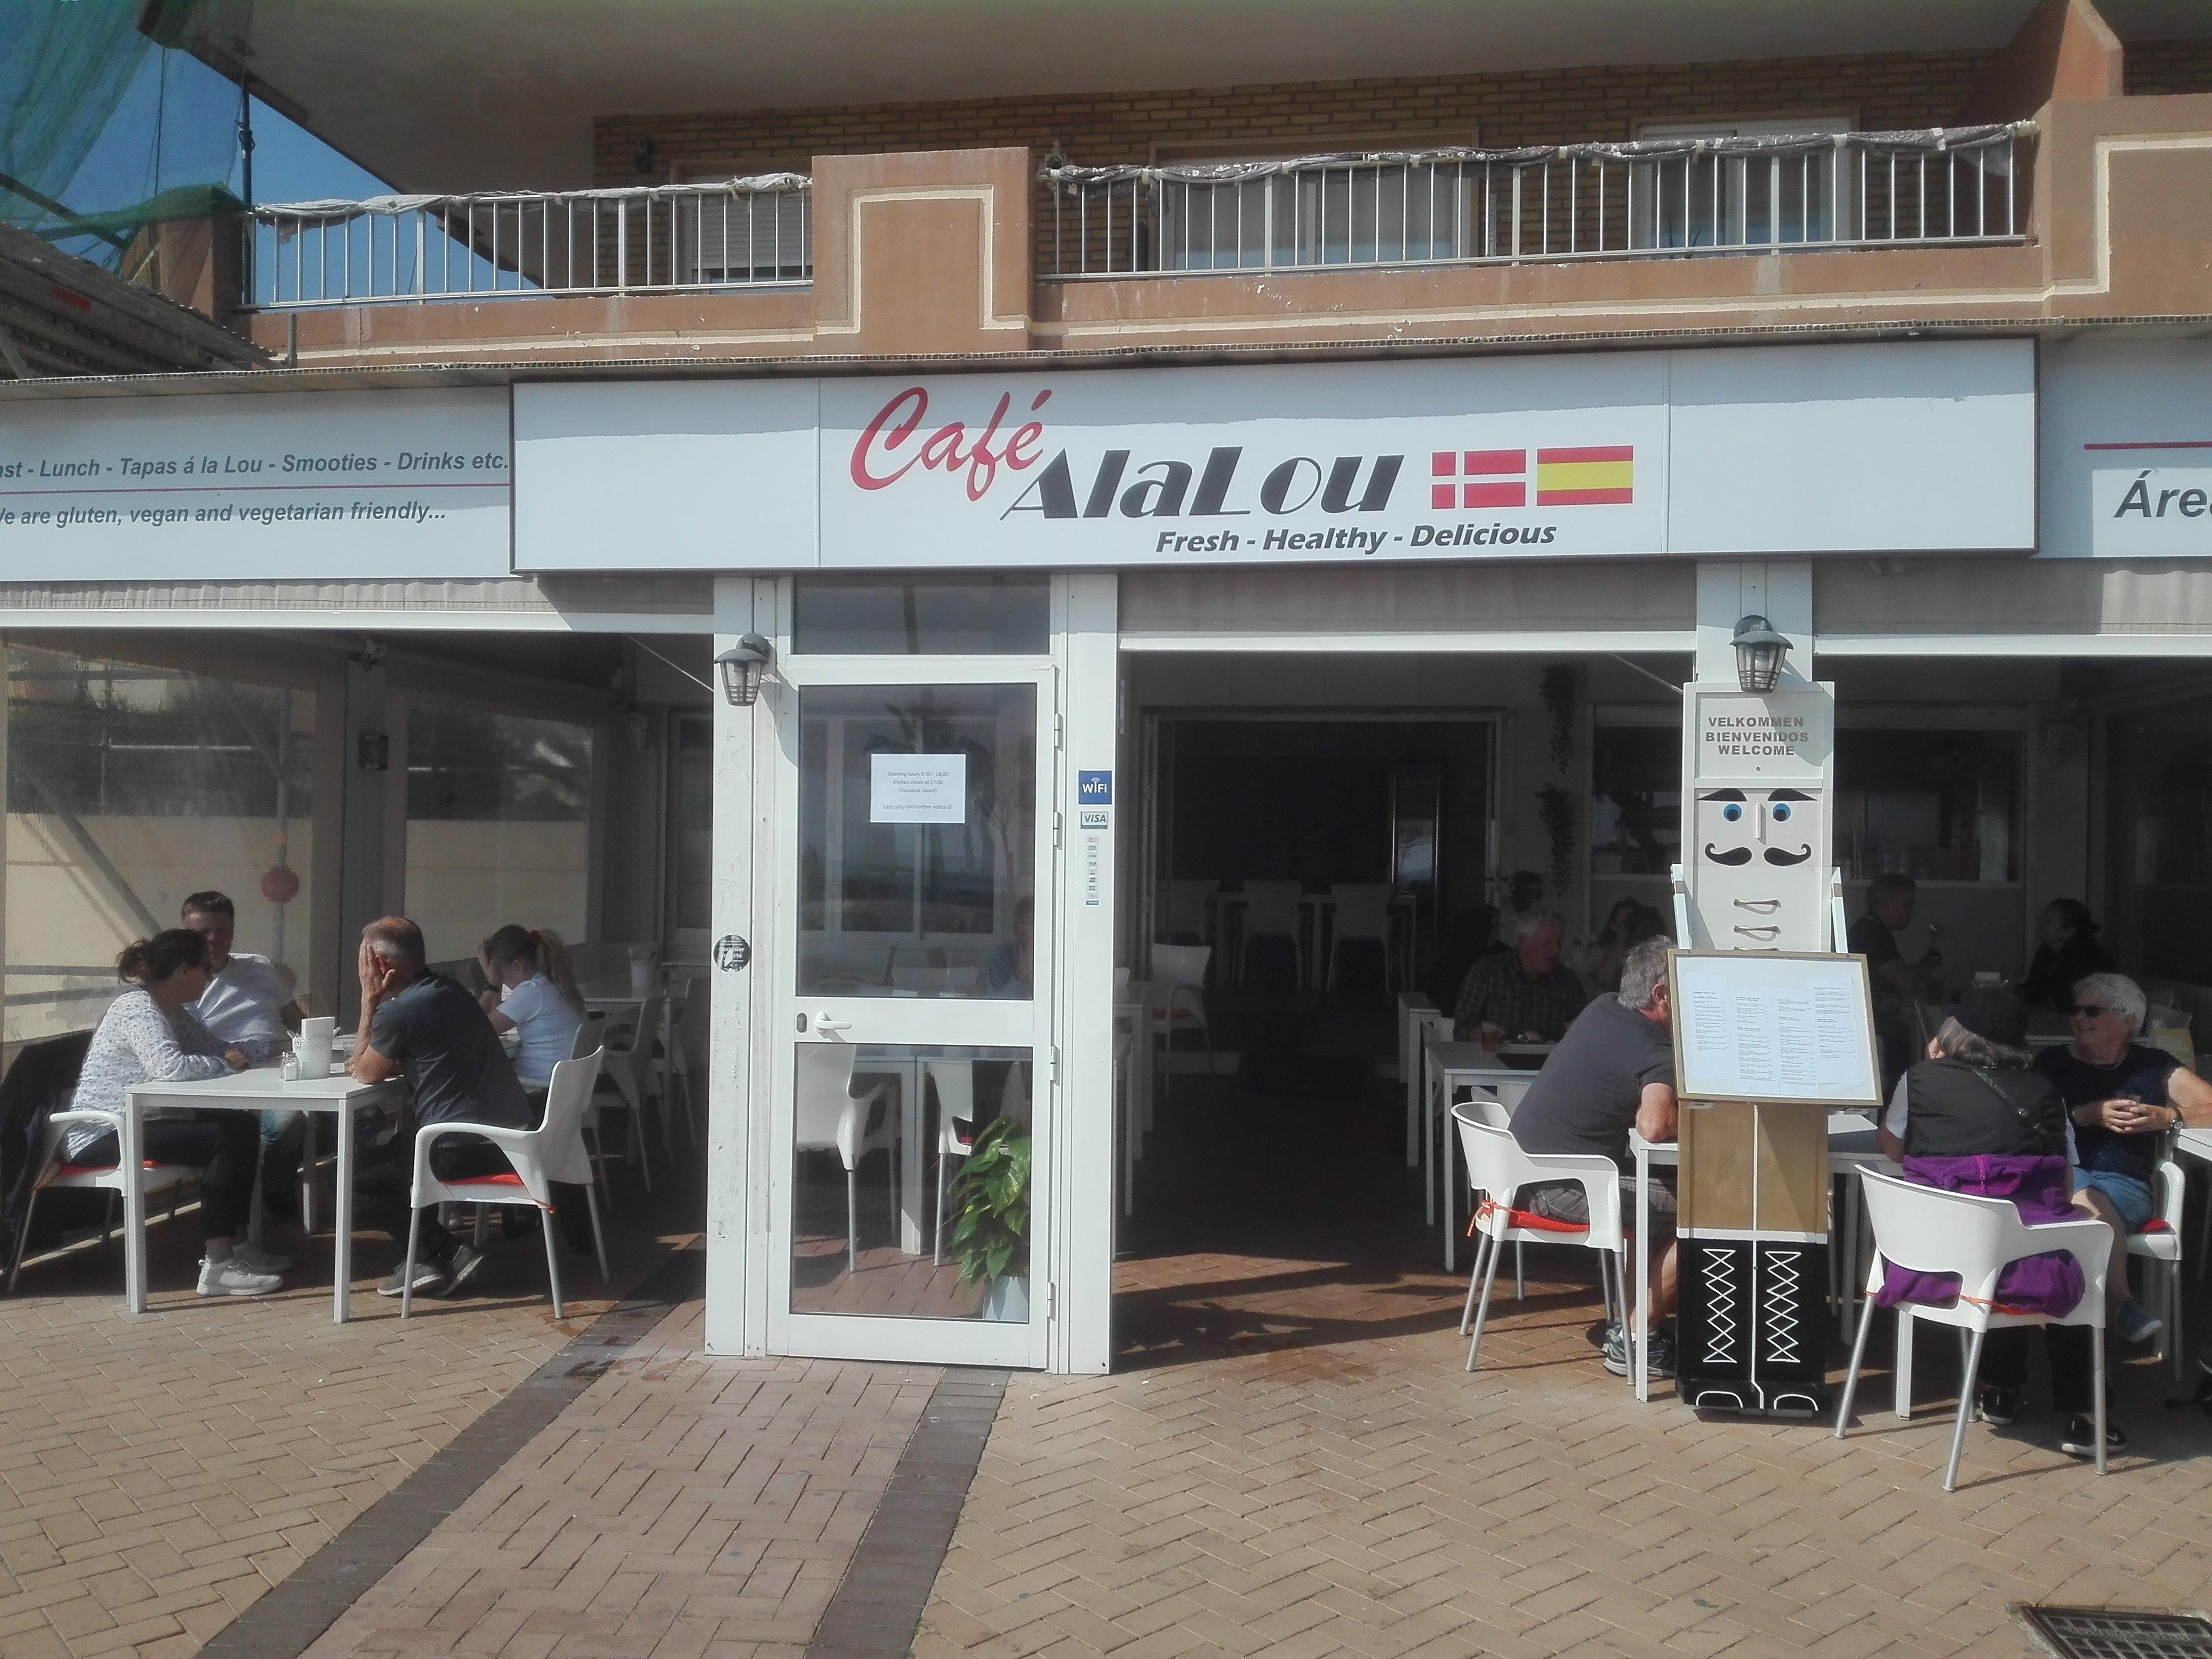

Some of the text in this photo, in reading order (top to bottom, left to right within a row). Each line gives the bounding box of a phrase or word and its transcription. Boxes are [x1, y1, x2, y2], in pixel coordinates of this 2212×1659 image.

[850, 387, 1052, 501] Café
[0, 461, 23, 477] st
[39, 458, 100, 477] Lunch
[120, 457, 178, 479] Tapas
[183, 456, 195, 474] á
[200, 456, 218, 474] la
[224, 456, 263, 473] Lou
[281, 453, 378, 473] Smooties
[397, 451, 465, 471] Drinks
[472, 451, 508, 470] etc.
[999, 446, 1405, 521] AlaLou
[2113, 470, 2212, 518] Áre
[0, 501, 446, 529] e are gluten, vegan and vegetarian friendly...
[1155, 530, 1239, 552] Fresh
[1262, 526, 1389, 555] Healthy
[1410, 523, 1557, 547] Delicious
[1708, 717, 1804, 727] VELKOMMEN
[1705, 732, 1809, 742] BIENVENIDOS
[1718, 745, 1795, 756] WELCOME
[1082, 783, 1107, 793] WiFi
[1084, 814, 1107, 823] VISA
